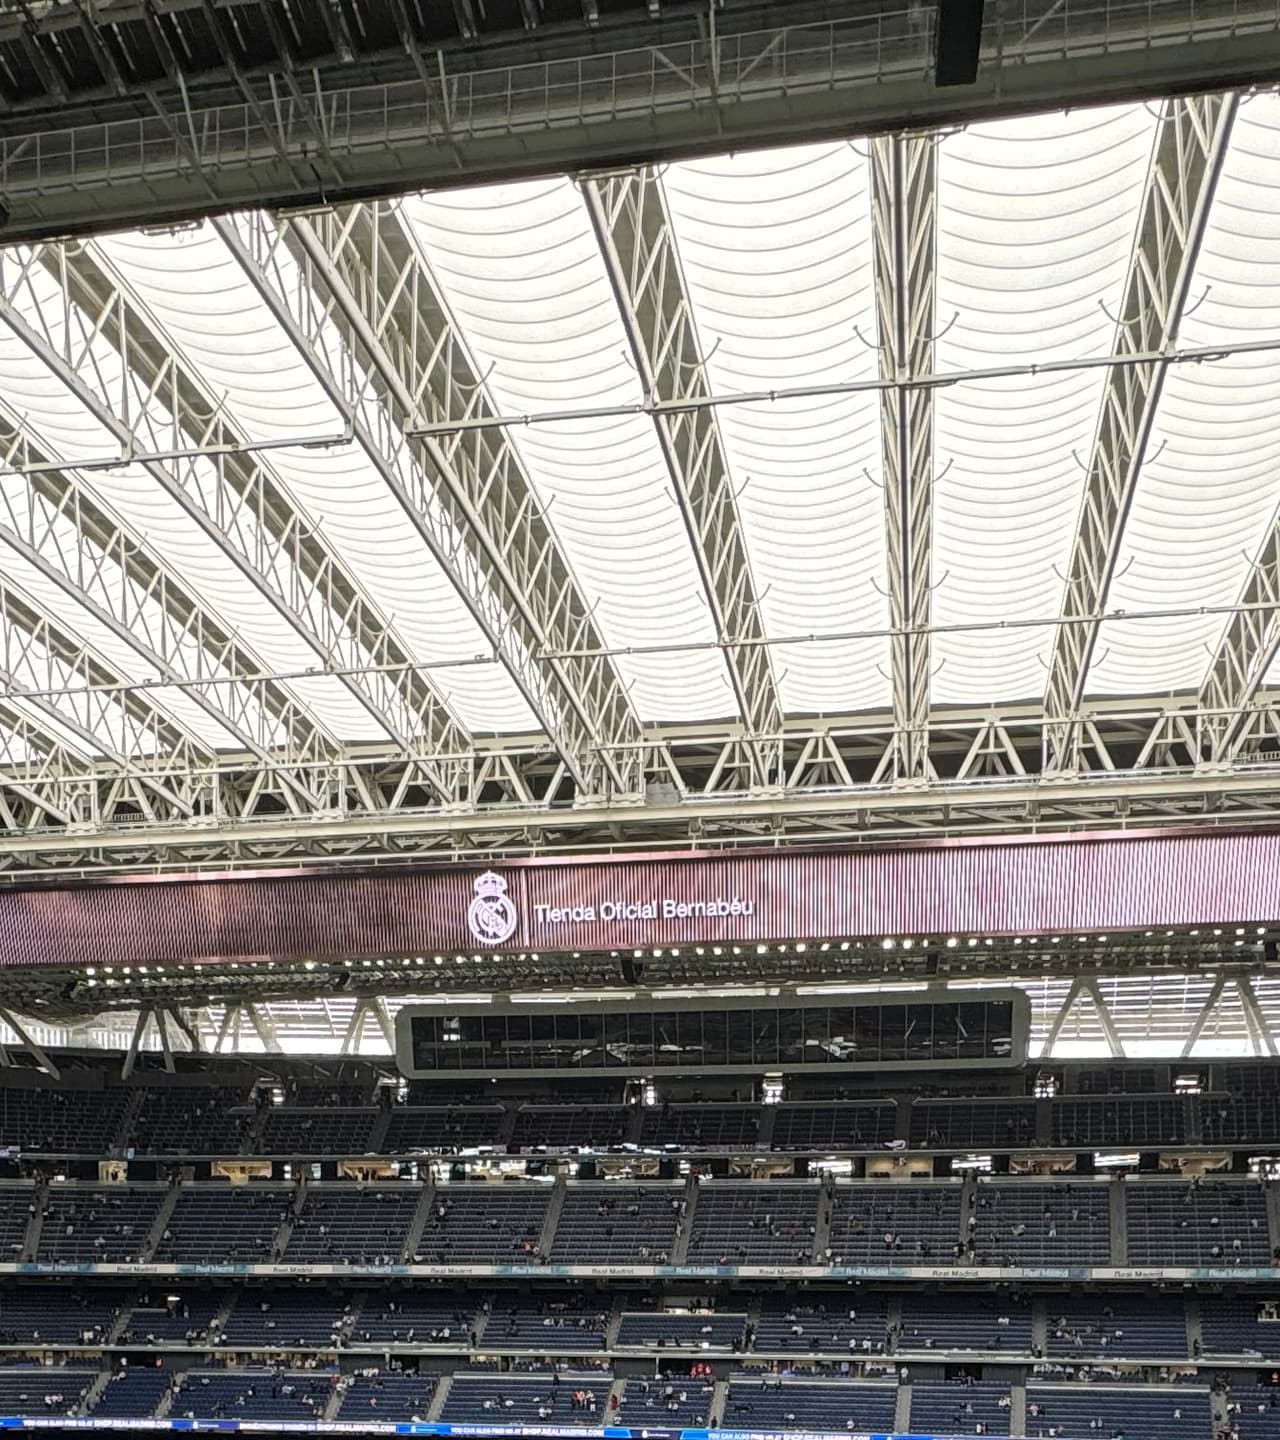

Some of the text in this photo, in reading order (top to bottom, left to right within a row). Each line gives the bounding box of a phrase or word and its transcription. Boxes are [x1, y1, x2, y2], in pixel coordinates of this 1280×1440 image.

[534, 897, 753, 923] Tienda Oficial Bernabéu
